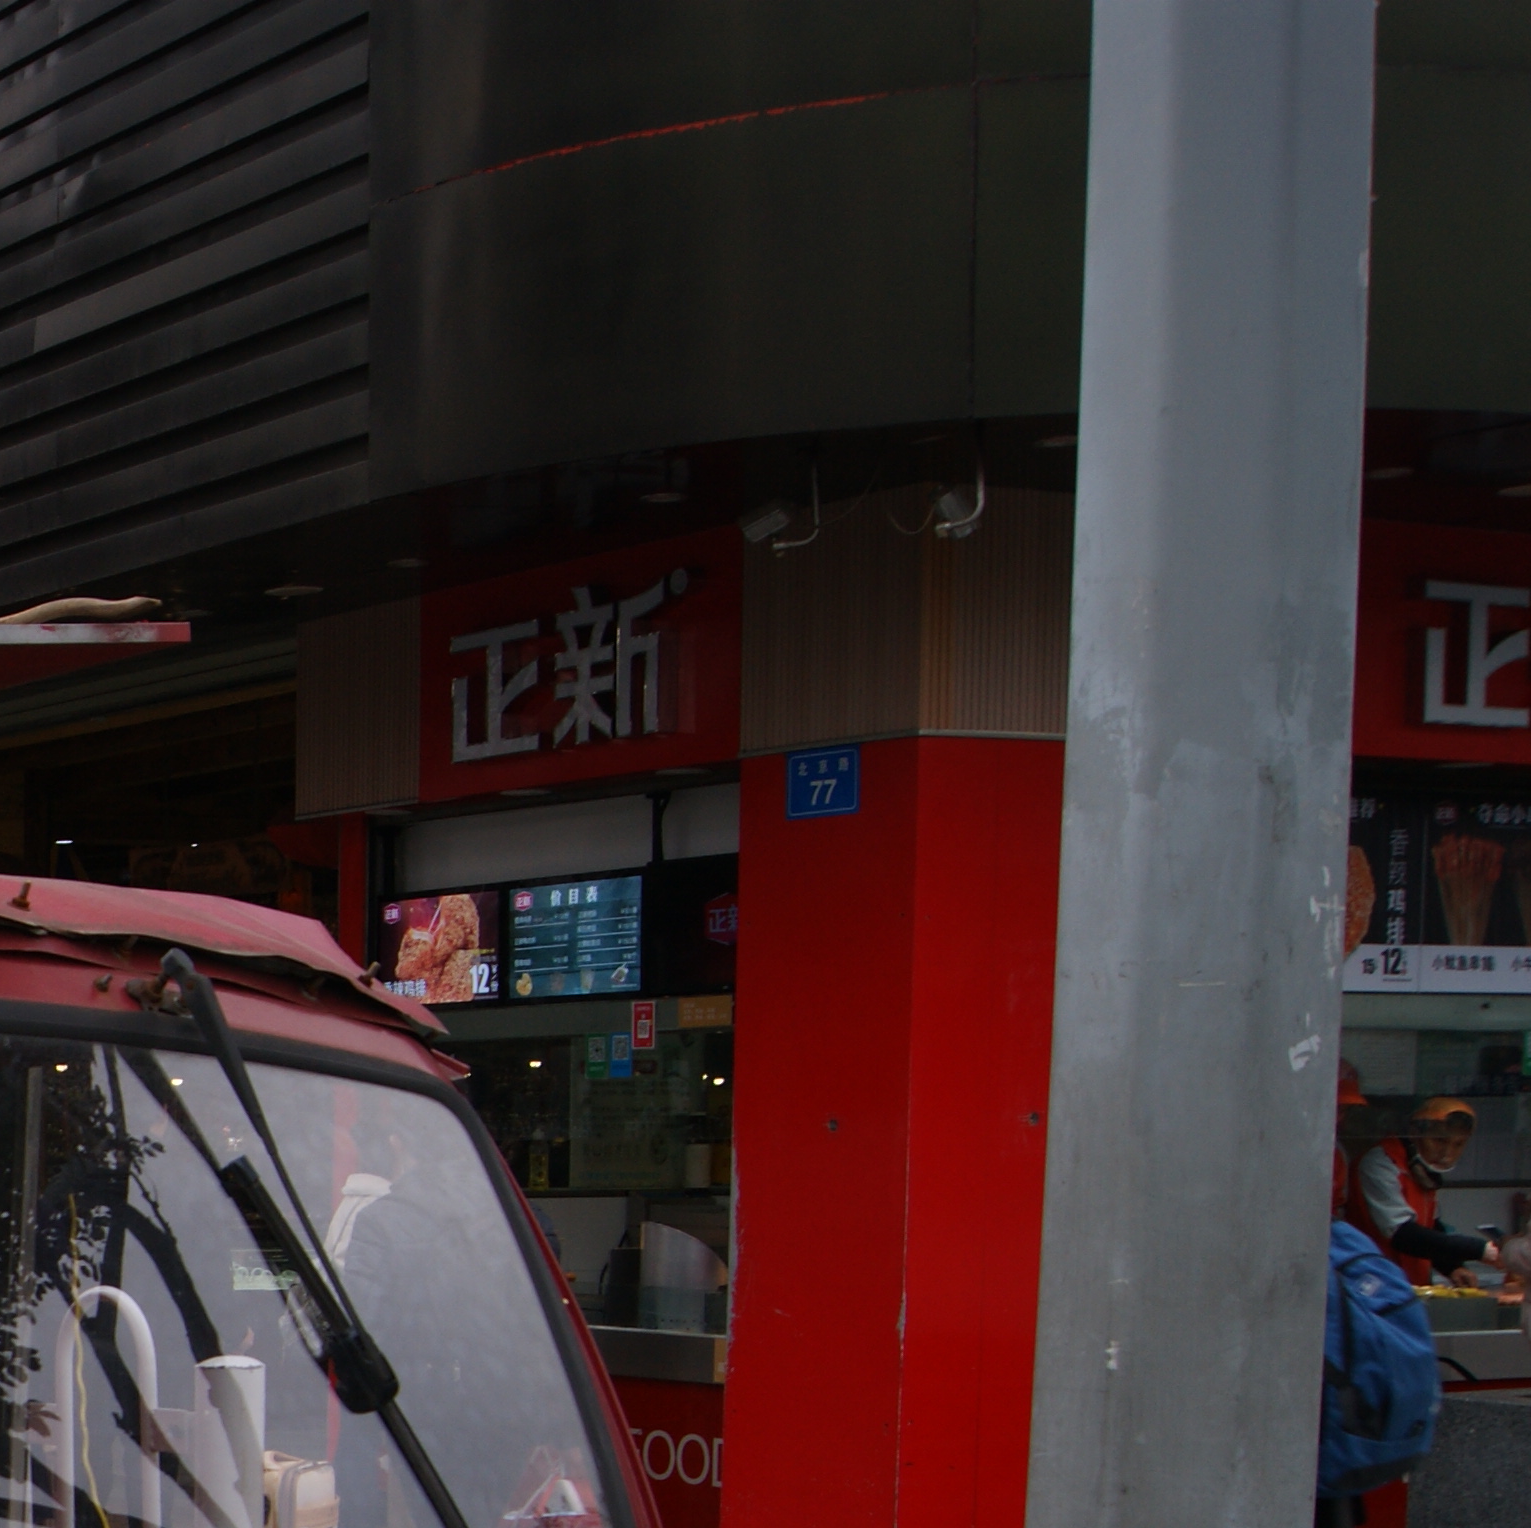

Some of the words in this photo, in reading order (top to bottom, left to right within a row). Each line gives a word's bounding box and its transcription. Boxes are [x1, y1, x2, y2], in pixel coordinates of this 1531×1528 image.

[450, 567, 688, 763] 正新
[797, 756, 849, 777] 北京路
[809, 778, 837, 806] 77
[550, 886, 598, 906] 价目表
[1381, 947, 1402, 974] 12
[469, 963, 490, 994] 12
